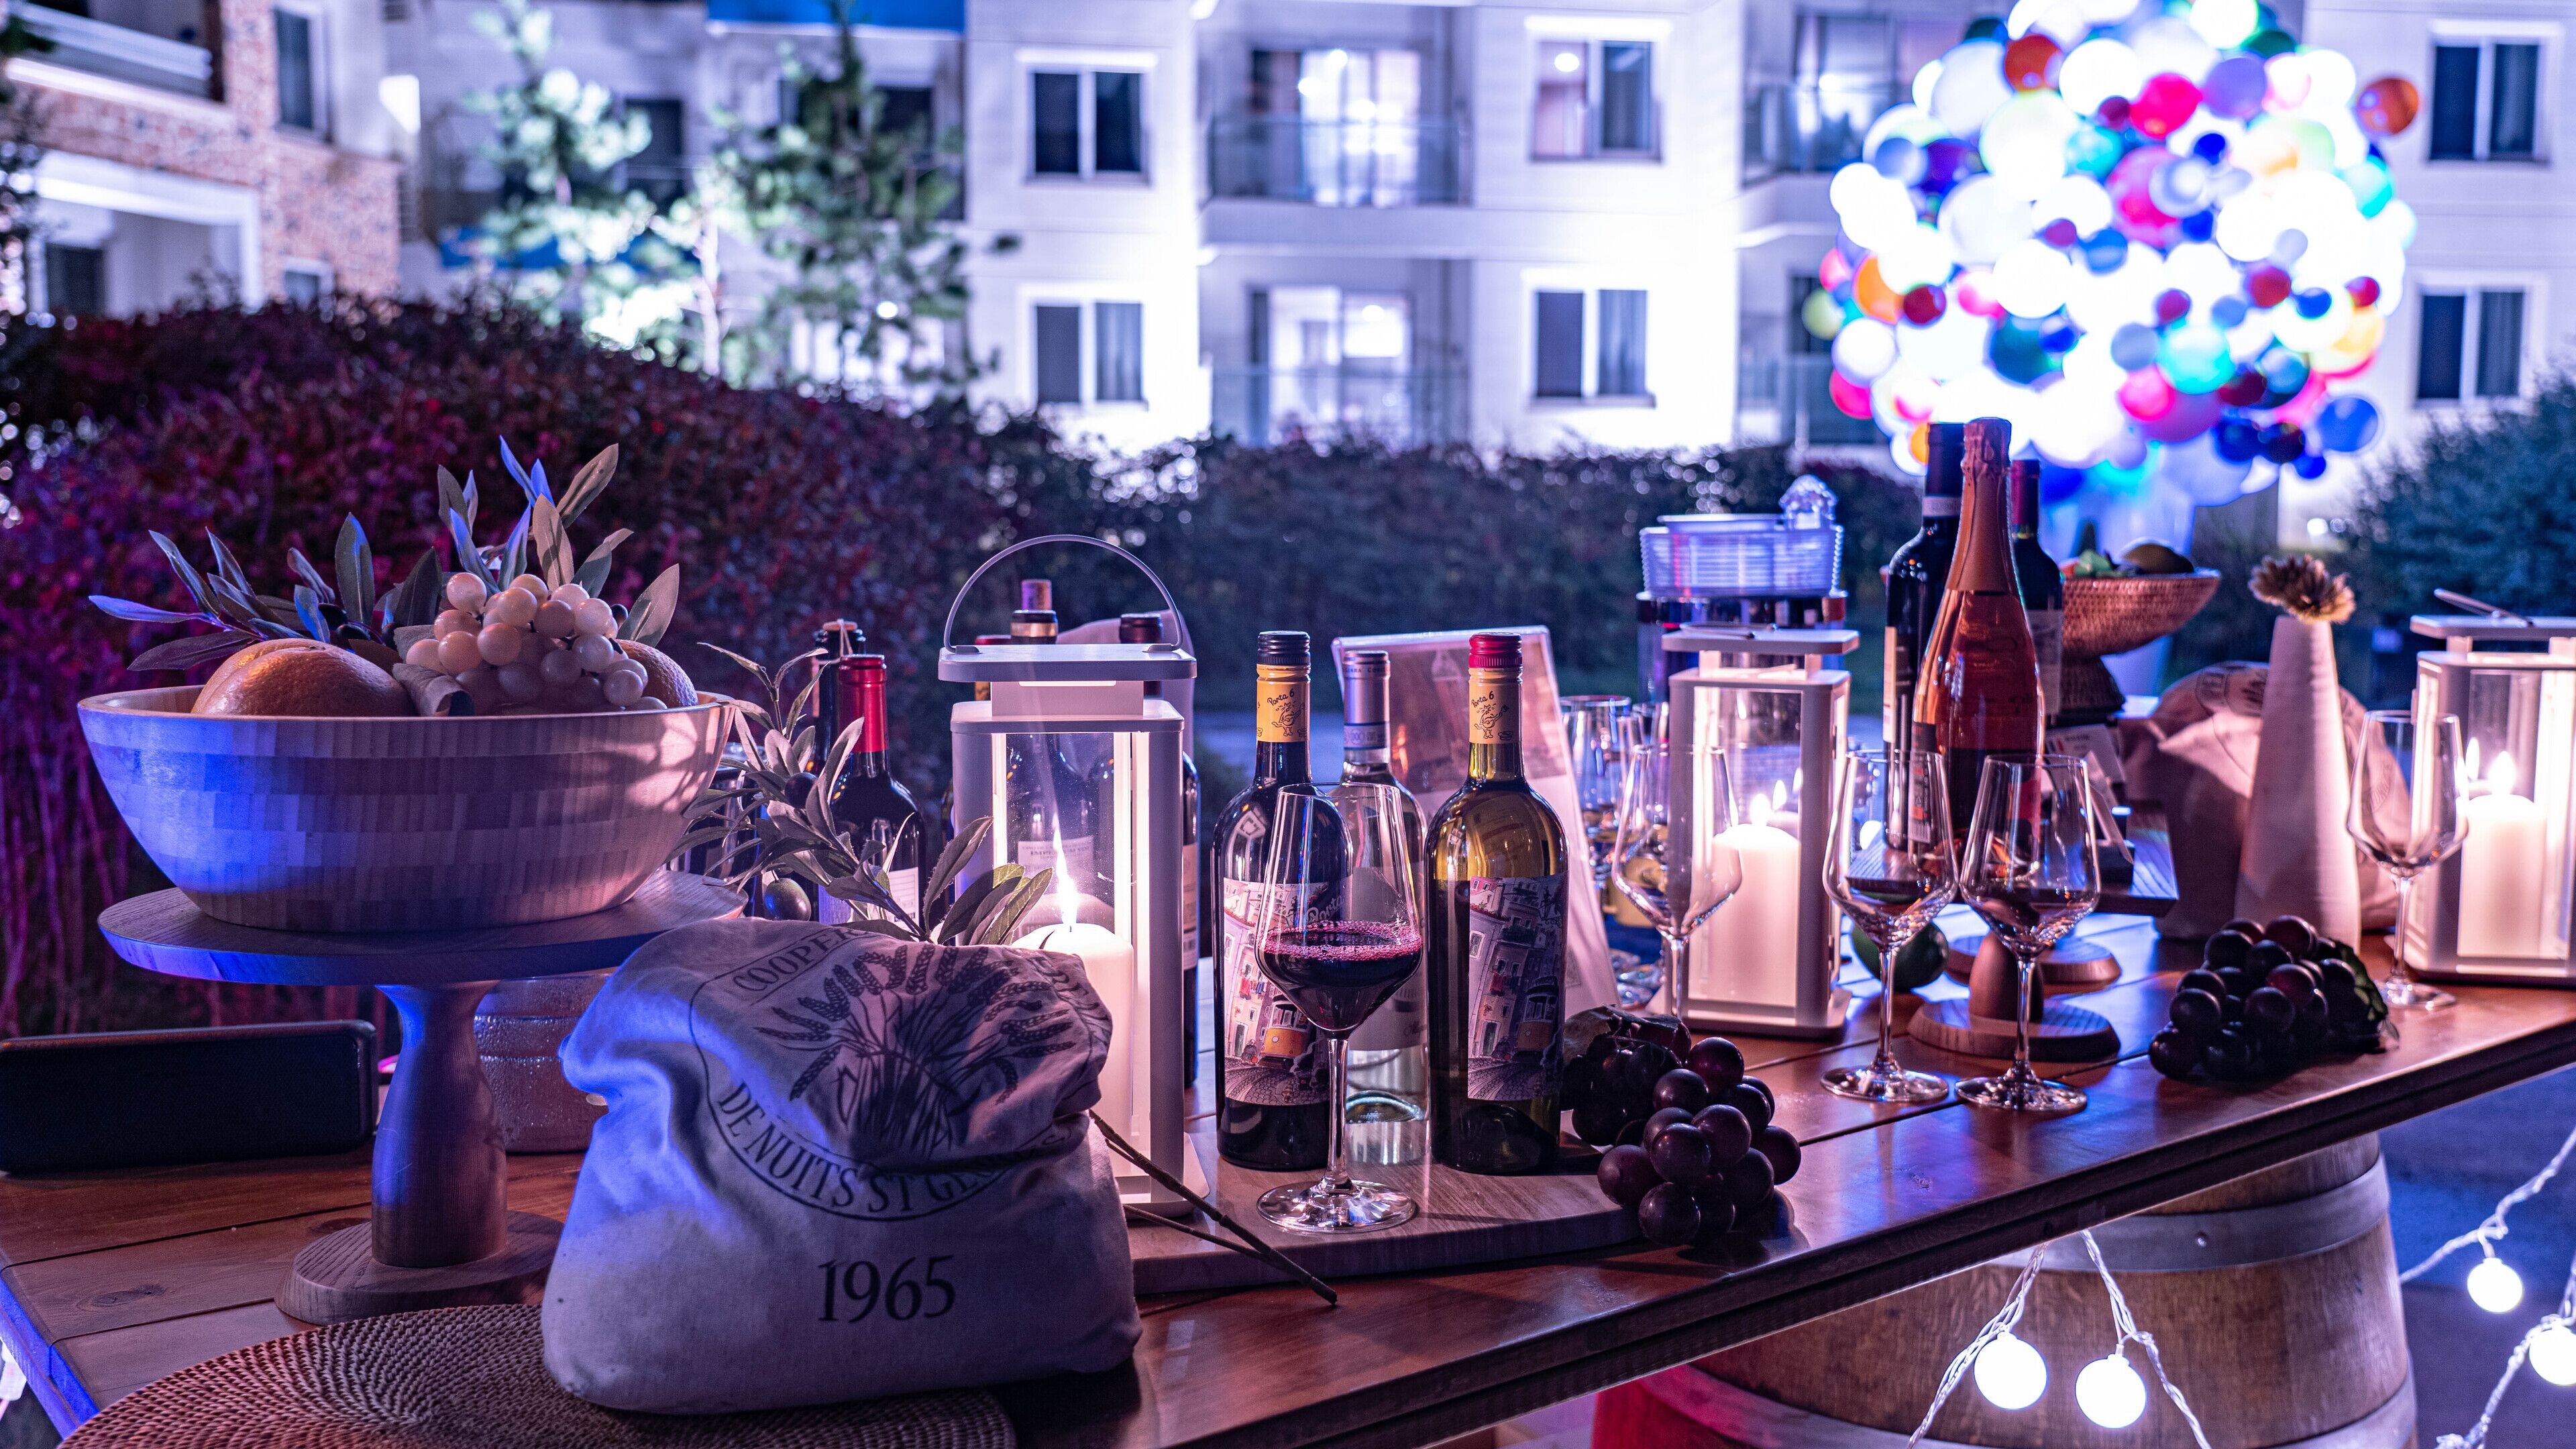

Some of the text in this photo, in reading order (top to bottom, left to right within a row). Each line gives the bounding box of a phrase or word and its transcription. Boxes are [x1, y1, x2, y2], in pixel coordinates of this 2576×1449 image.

[1267, 688, 1295, 706] Porta 6
[1471, 691, 1495, 708] Porta 6
[718, 1079, 765, 1137] DE
[743, 1121, 858, 1207] NUITS
[818, 1254, 955, 1323] 1965
